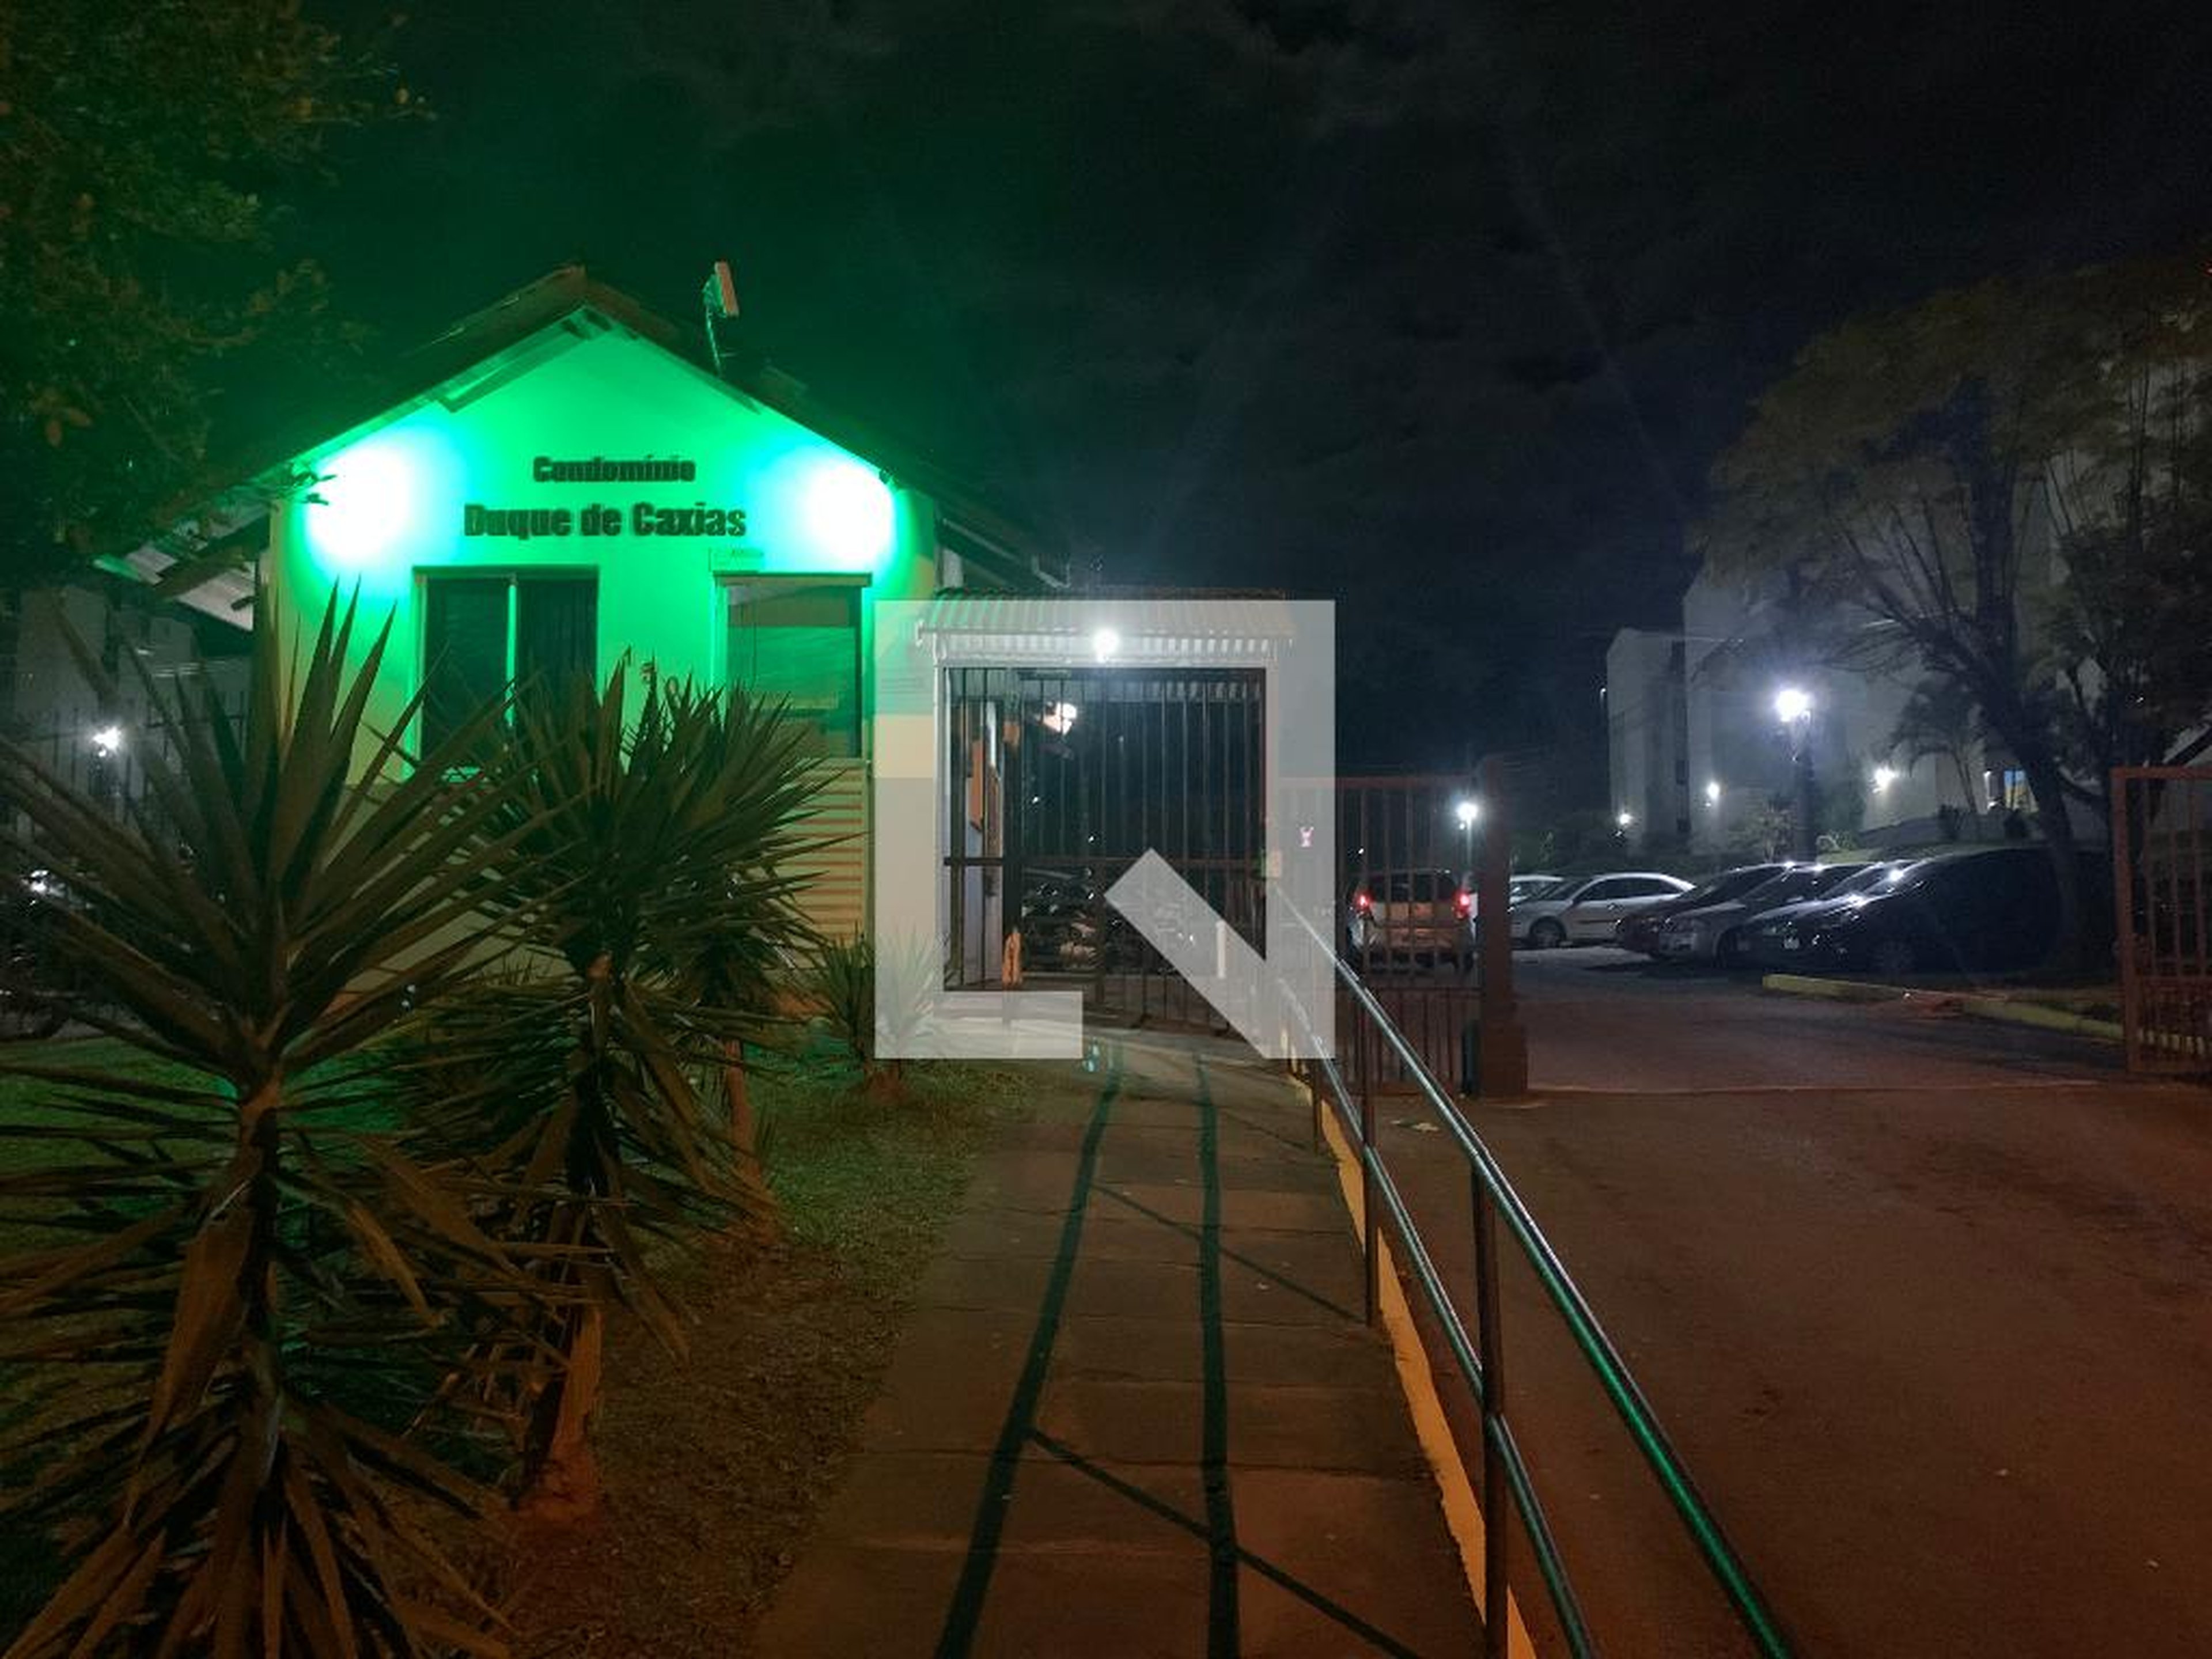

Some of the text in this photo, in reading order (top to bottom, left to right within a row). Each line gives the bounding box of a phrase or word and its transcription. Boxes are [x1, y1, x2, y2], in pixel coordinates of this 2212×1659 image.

[464, 502, 746, 540] Duque de Caxias
